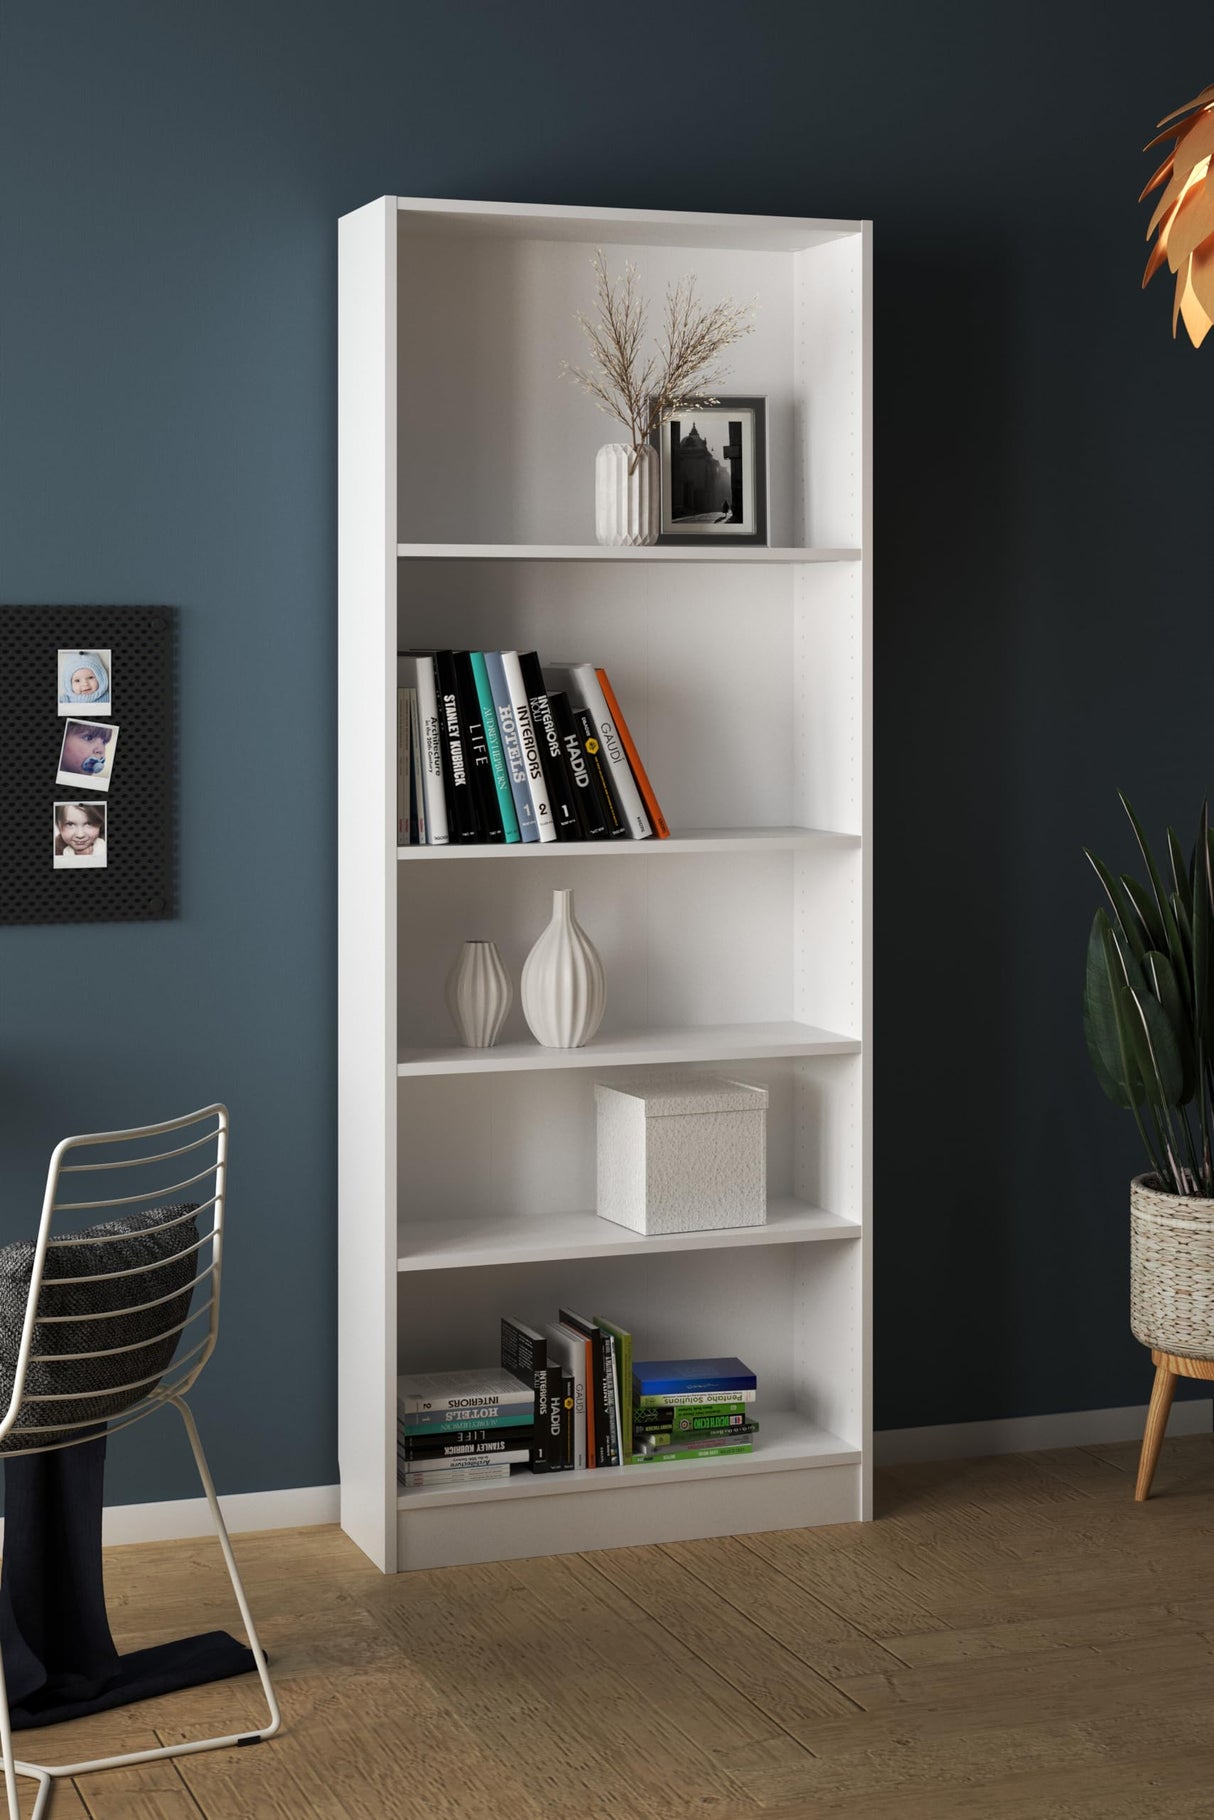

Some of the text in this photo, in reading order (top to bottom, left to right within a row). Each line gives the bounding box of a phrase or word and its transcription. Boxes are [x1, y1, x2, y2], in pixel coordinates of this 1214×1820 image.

[443, 694, 467, 787] STANLEY KUBRICK
[469, 723, 489, 766] LIFE
[499, 703, 527, 784] HOTELS
[516, 705, 542, 780] INTERIORS
[537, 695, 561, 758] INTERIORS
[600, 722, 625, 764] GAUDÍ
[431, 717, 440, 776] Architecture
[563, 733, 590, 788] HADID
[523, 804, 531, 816] 1
[538, 803, 548, 816] 2
[561, 804, 569, 817] 1
[448, 1396, 499, 1409] INTERIORS
[539, 1370, 548, 1415] INTERIORS
[664, 1396, 704, 1405] Solutions
[707, 1394, 743, 1402] Pentaho
[445, 1407, 499, 1422] HOTELS
[550, 1397, 561, 1436] HADID
[444, 1441, 506, 1456] STANLEY KUBRICK
[457, 1430, 486, 1442] LIFE
